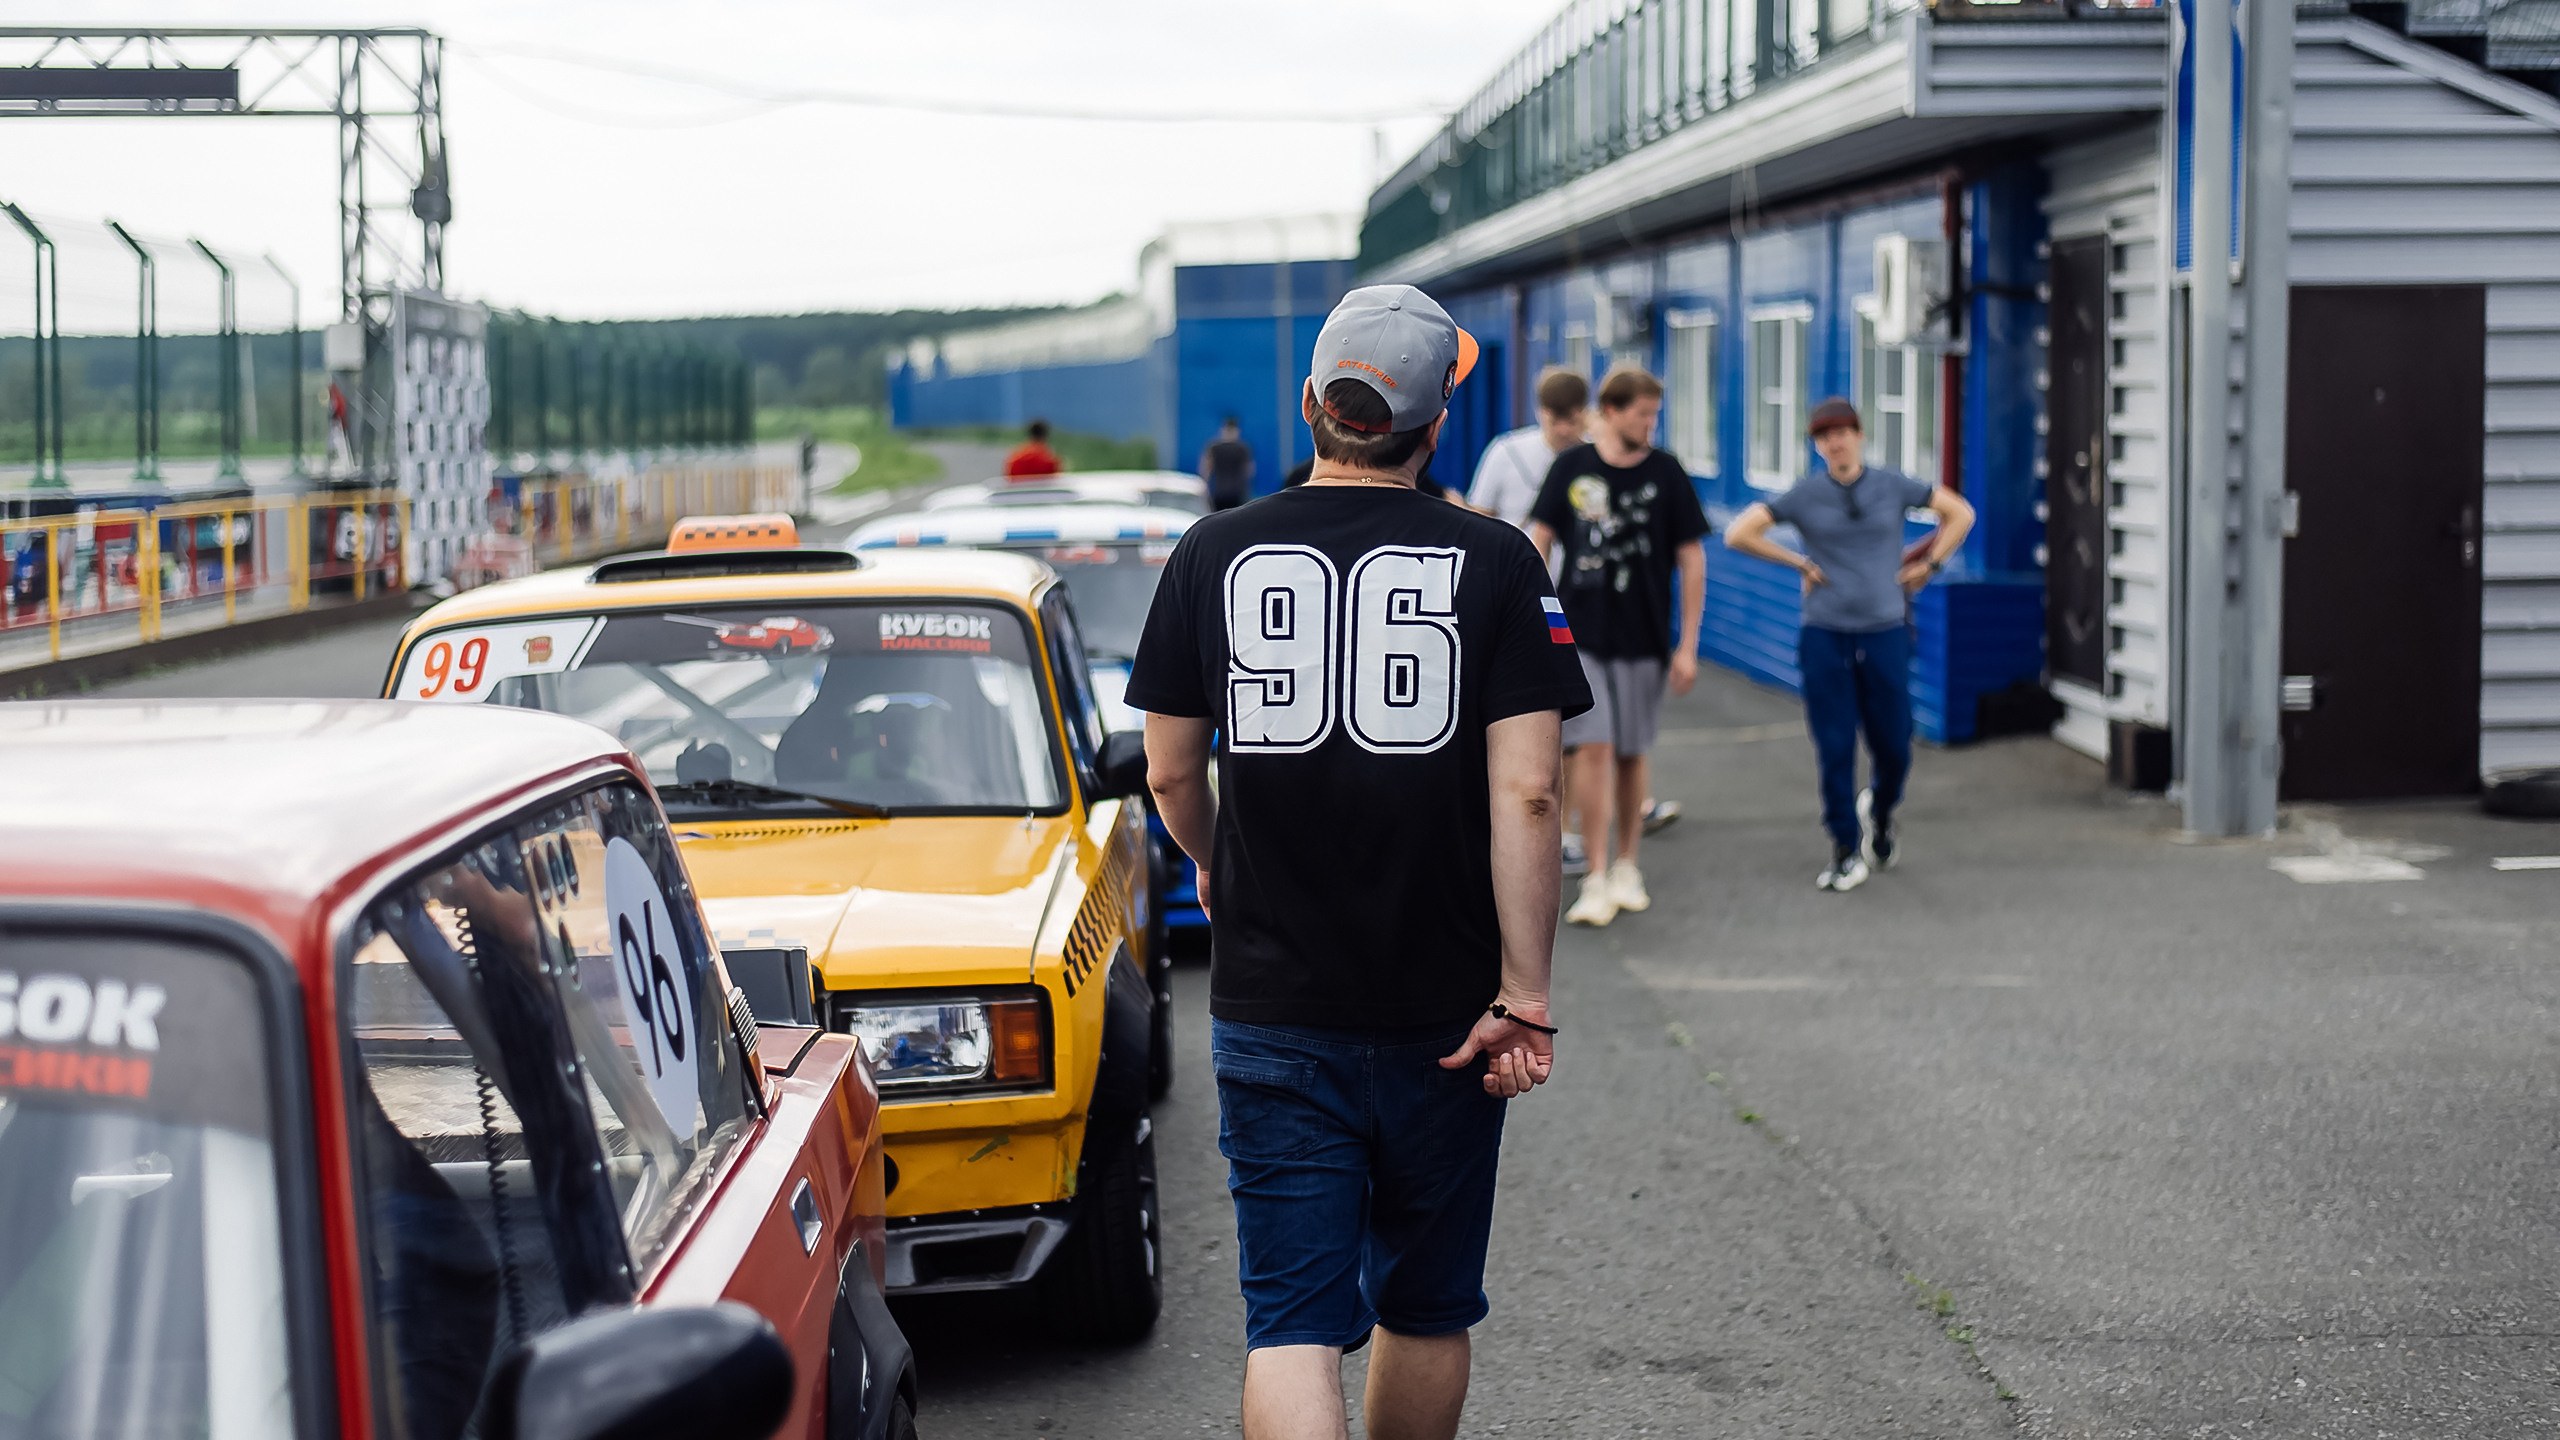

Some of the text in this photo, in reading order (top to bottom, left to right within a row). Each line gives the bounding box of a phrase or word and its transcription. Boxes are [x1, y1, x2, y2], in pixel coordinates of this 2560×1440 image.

[880, 613, 991, 640] КУБОК
[1223, 543, 1467, 755] 96
[419, 637, 490, 699] 99
[0, 970, 167, 1052] ОК
[618, 897, 686, 1079] 96
